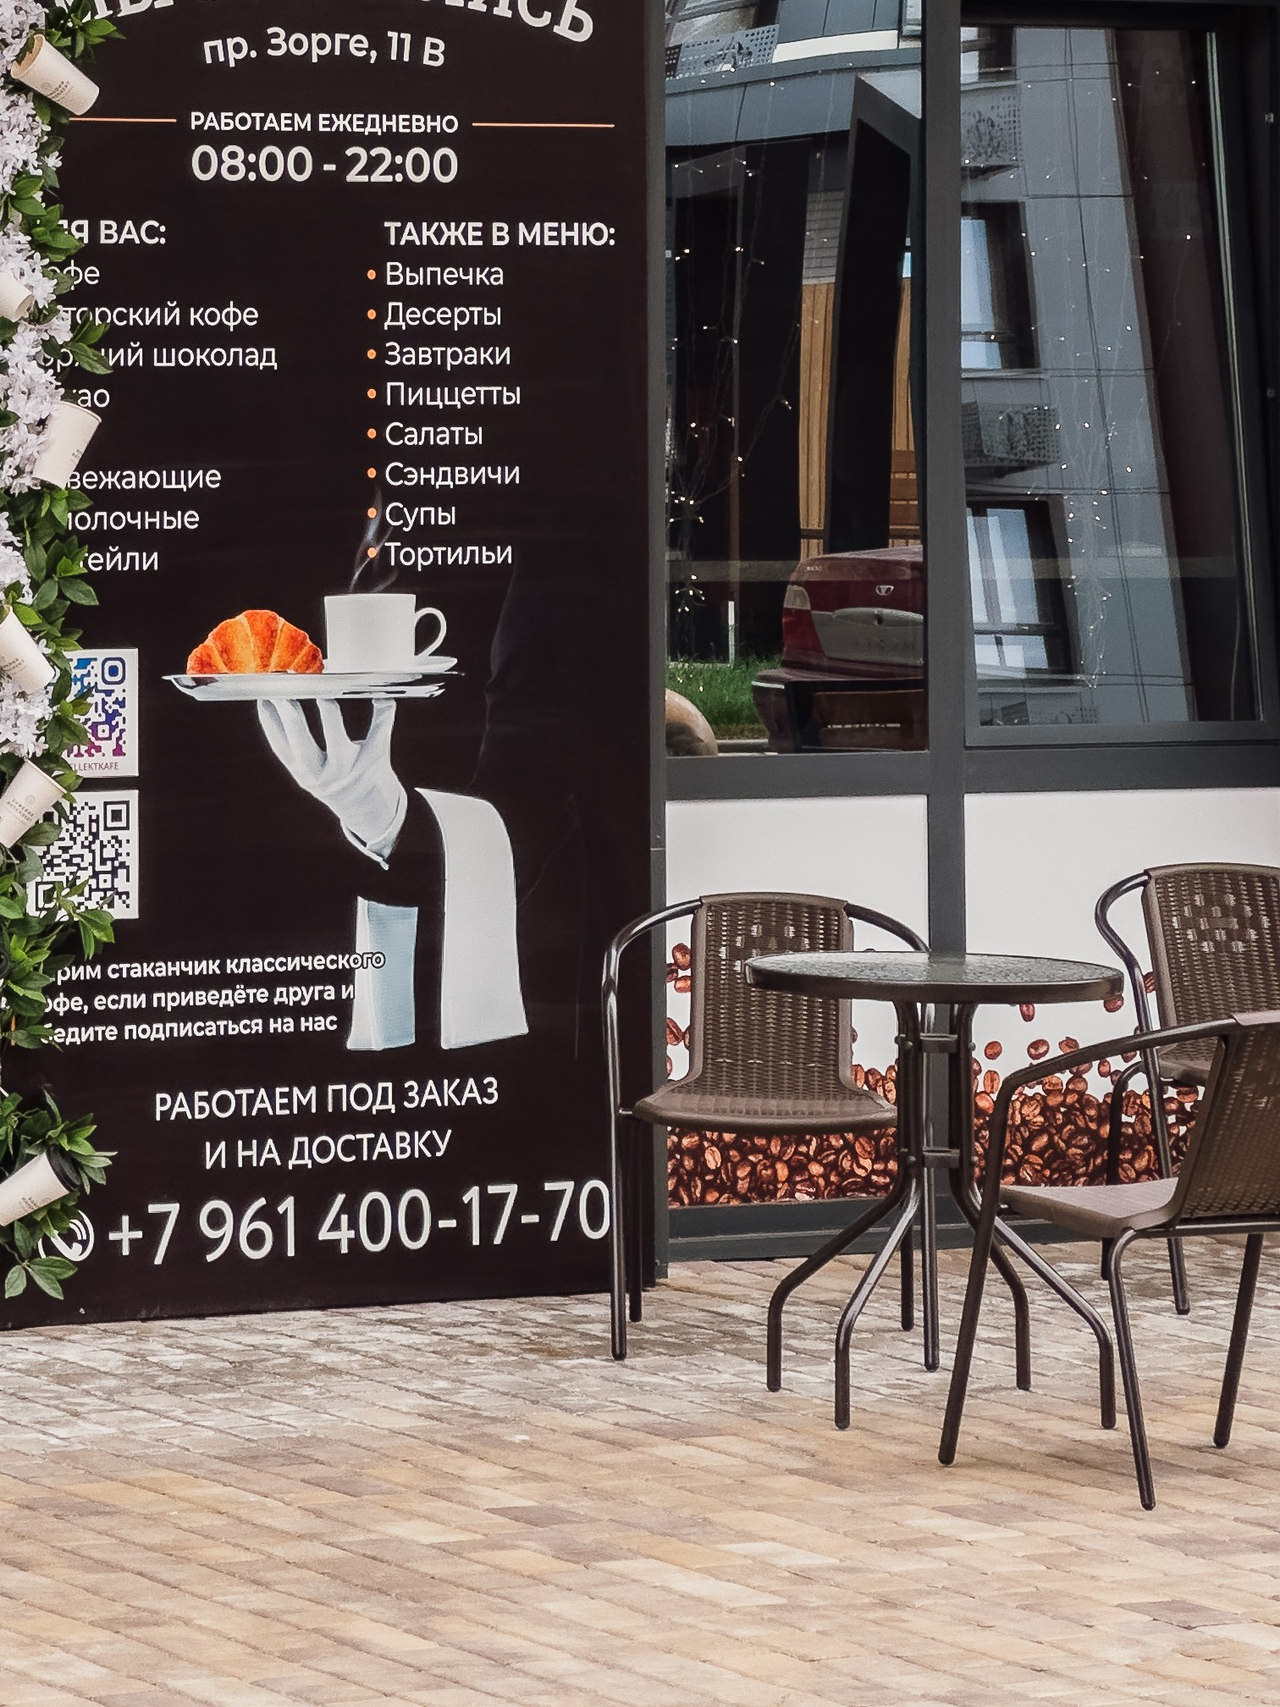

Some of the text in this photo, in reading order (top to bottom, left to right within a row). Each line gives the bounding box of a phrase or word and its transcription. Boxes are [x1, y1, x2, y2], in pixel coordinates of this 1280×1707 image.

[204, 27, 445, 67] пр. Зорге, 11 В
[191, 112, 458, 135] РАБОТАЕМ ЕЖЕДНЕВНО
[192, 145, 312, 182] 08:00
[345, 147, 457, 183] 22:00
[100, 220, 166, 245] ВАС:
[384, 222, 616, 246] ТАКЖЕ В МЕНЮ:
[387, 262, 504, 286] Выпечка
[63, 301, 258, 332] торский кофе
[384, 302, 501, 331] Десерты
[154, 348, 278, 370] шоколад
[385, 342, 511, 371] Завтраки
[387, 382, 521, 409] Пиццетты
[386, 422, 483, 446] Салаты
[68, 469, 222, 492] вежающие
[386, 462, 520, 489] Сэндвичи
[386, 502, 456, 531] Супы
[387, 542, 512, 571] Тортильи
[57, 952, 385, 986] рим стаканчик классического
[45, 984, 355, 1017] офе, если приведёте друга и
[42, 1015, 338, 1046] едите подписаться на нас
[155, 1077, 499, 1121] РАБОТАЕМ ПОД ЗАКАЗ
[205, 1130, 452, 1170] И НА ДОСТАВКУ
[109, 1180, 610, 1265] +7 961 400-17-70
